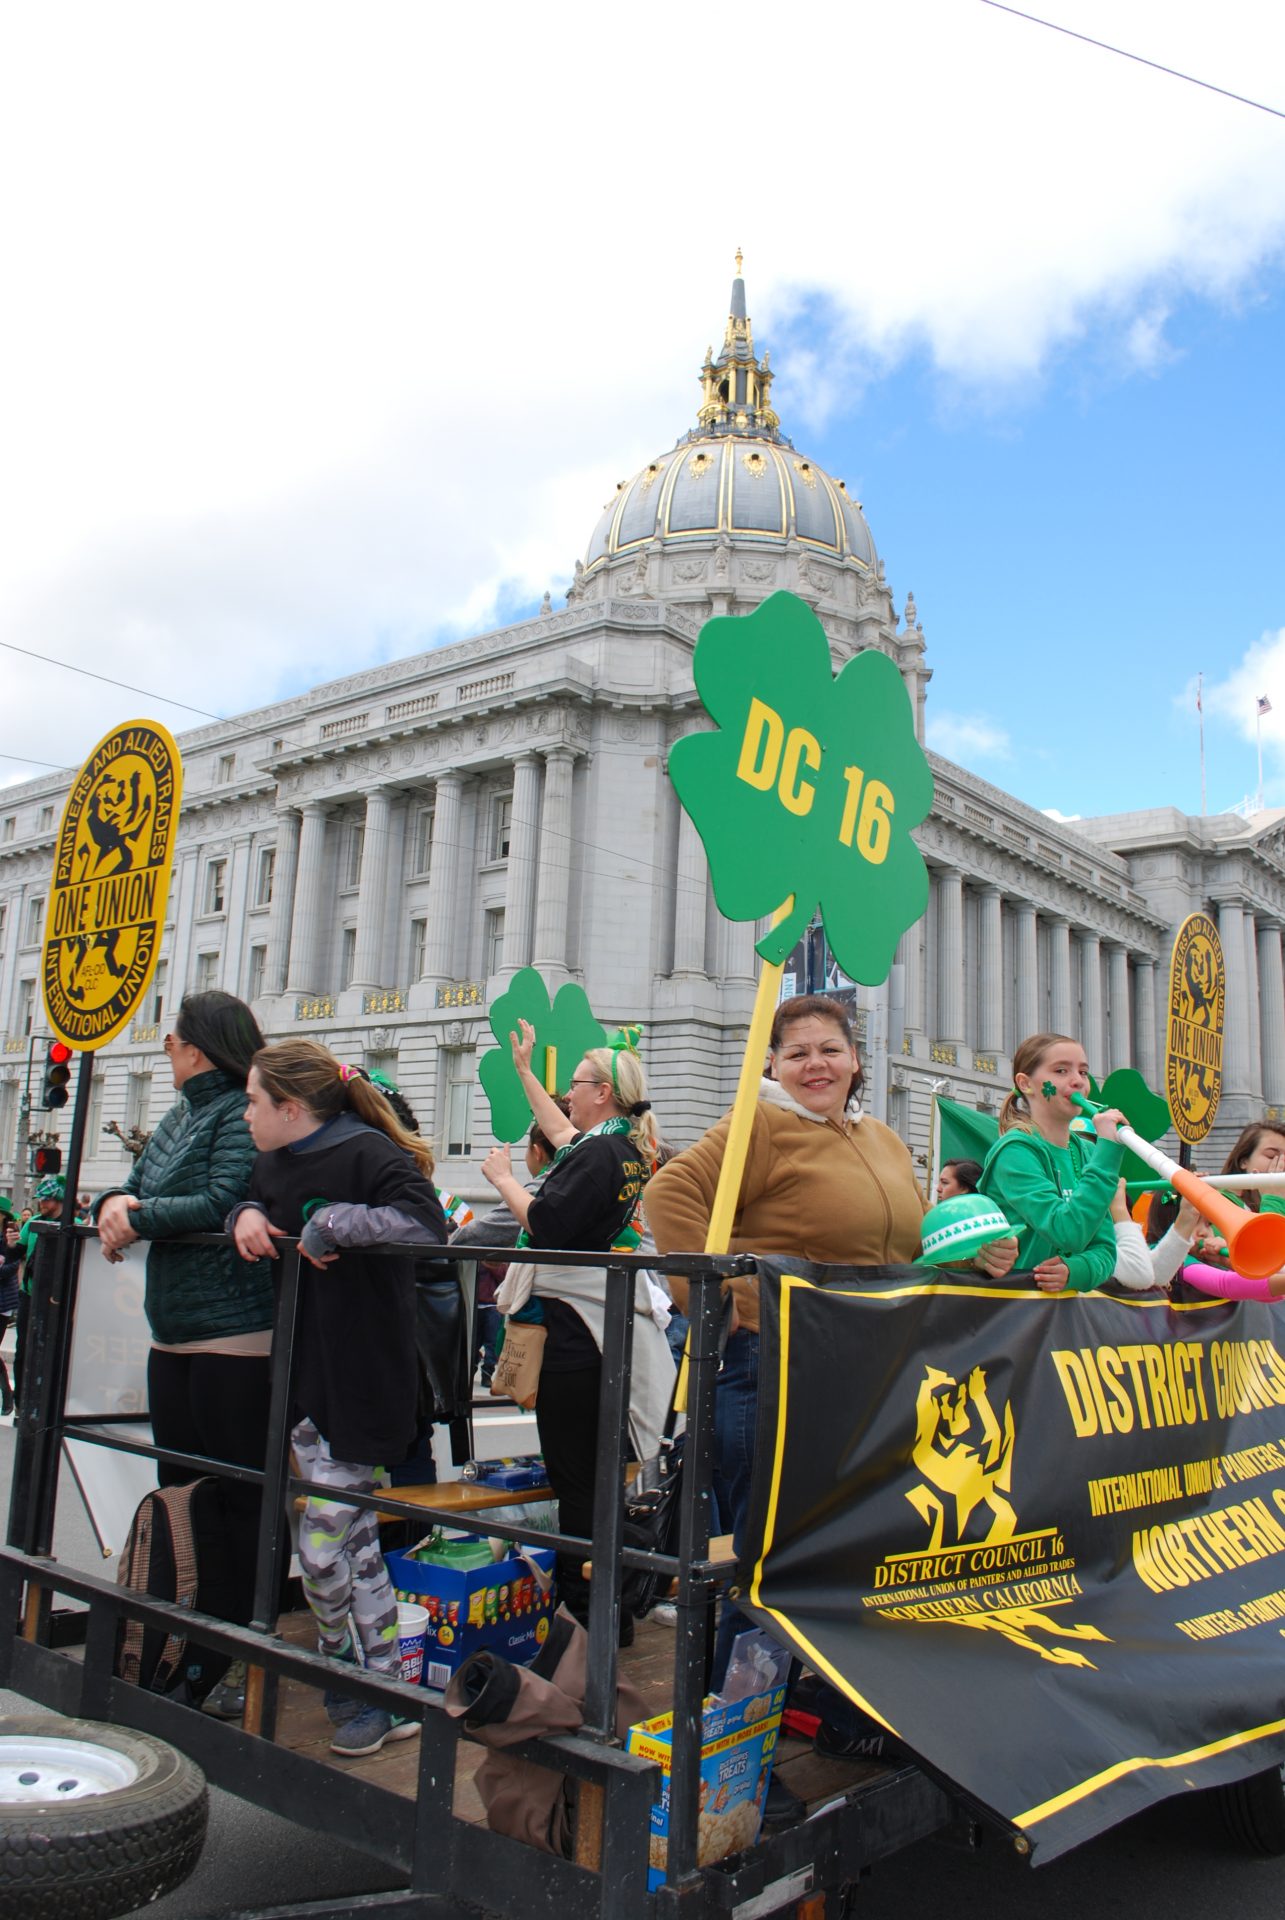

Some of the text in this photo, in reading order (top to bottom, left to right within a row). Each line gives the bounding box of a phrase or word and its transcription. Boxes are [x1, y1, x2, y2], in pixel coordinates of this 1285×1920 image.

[58, 731, 173, 881] PAINTERS AND ALLIED TRADES
[736, 696, 895, 865] DC 16
[53, 869, 159, 938] ONE UNION
[45, 928, 155, 1039] INTERNATIONAL UNION
[1172, 920, 1225, 1029] PAINTERS AND ALLIED TRADES
[1170, 1018, 1222, 1070] ONE UNION
[1168, 1062, 1221, 1139] INTERNATIONAL UNION
[1051, 1341, 1209, 1438] DISTRICT
[1088, 1465, 1184, 1517] INTERNATIONAL
[1183, 1459, 1213, 1497] UNION
[1211, 1456, 1227, 1489] OF
[1220, 1442, 1285, 1483] PAINTERS
[873, 1535, 1065, 1589] DISTRICT COUNCIL 16
[1132, 1496, 1285, 1594] NORTHERN
[861, 1558, 1076, 1608] INTERNATIONAL UNION OF PAINTERS AND ALLIED TRADES
[876, 1573, 1084, 1620] NORTHERN CALIFORNIA
[1174, 1609, 1248, 1641] PAINTERS
[719, 1761, 747, 1782] TREATS
[762, 1730, 776, 1754] 60
